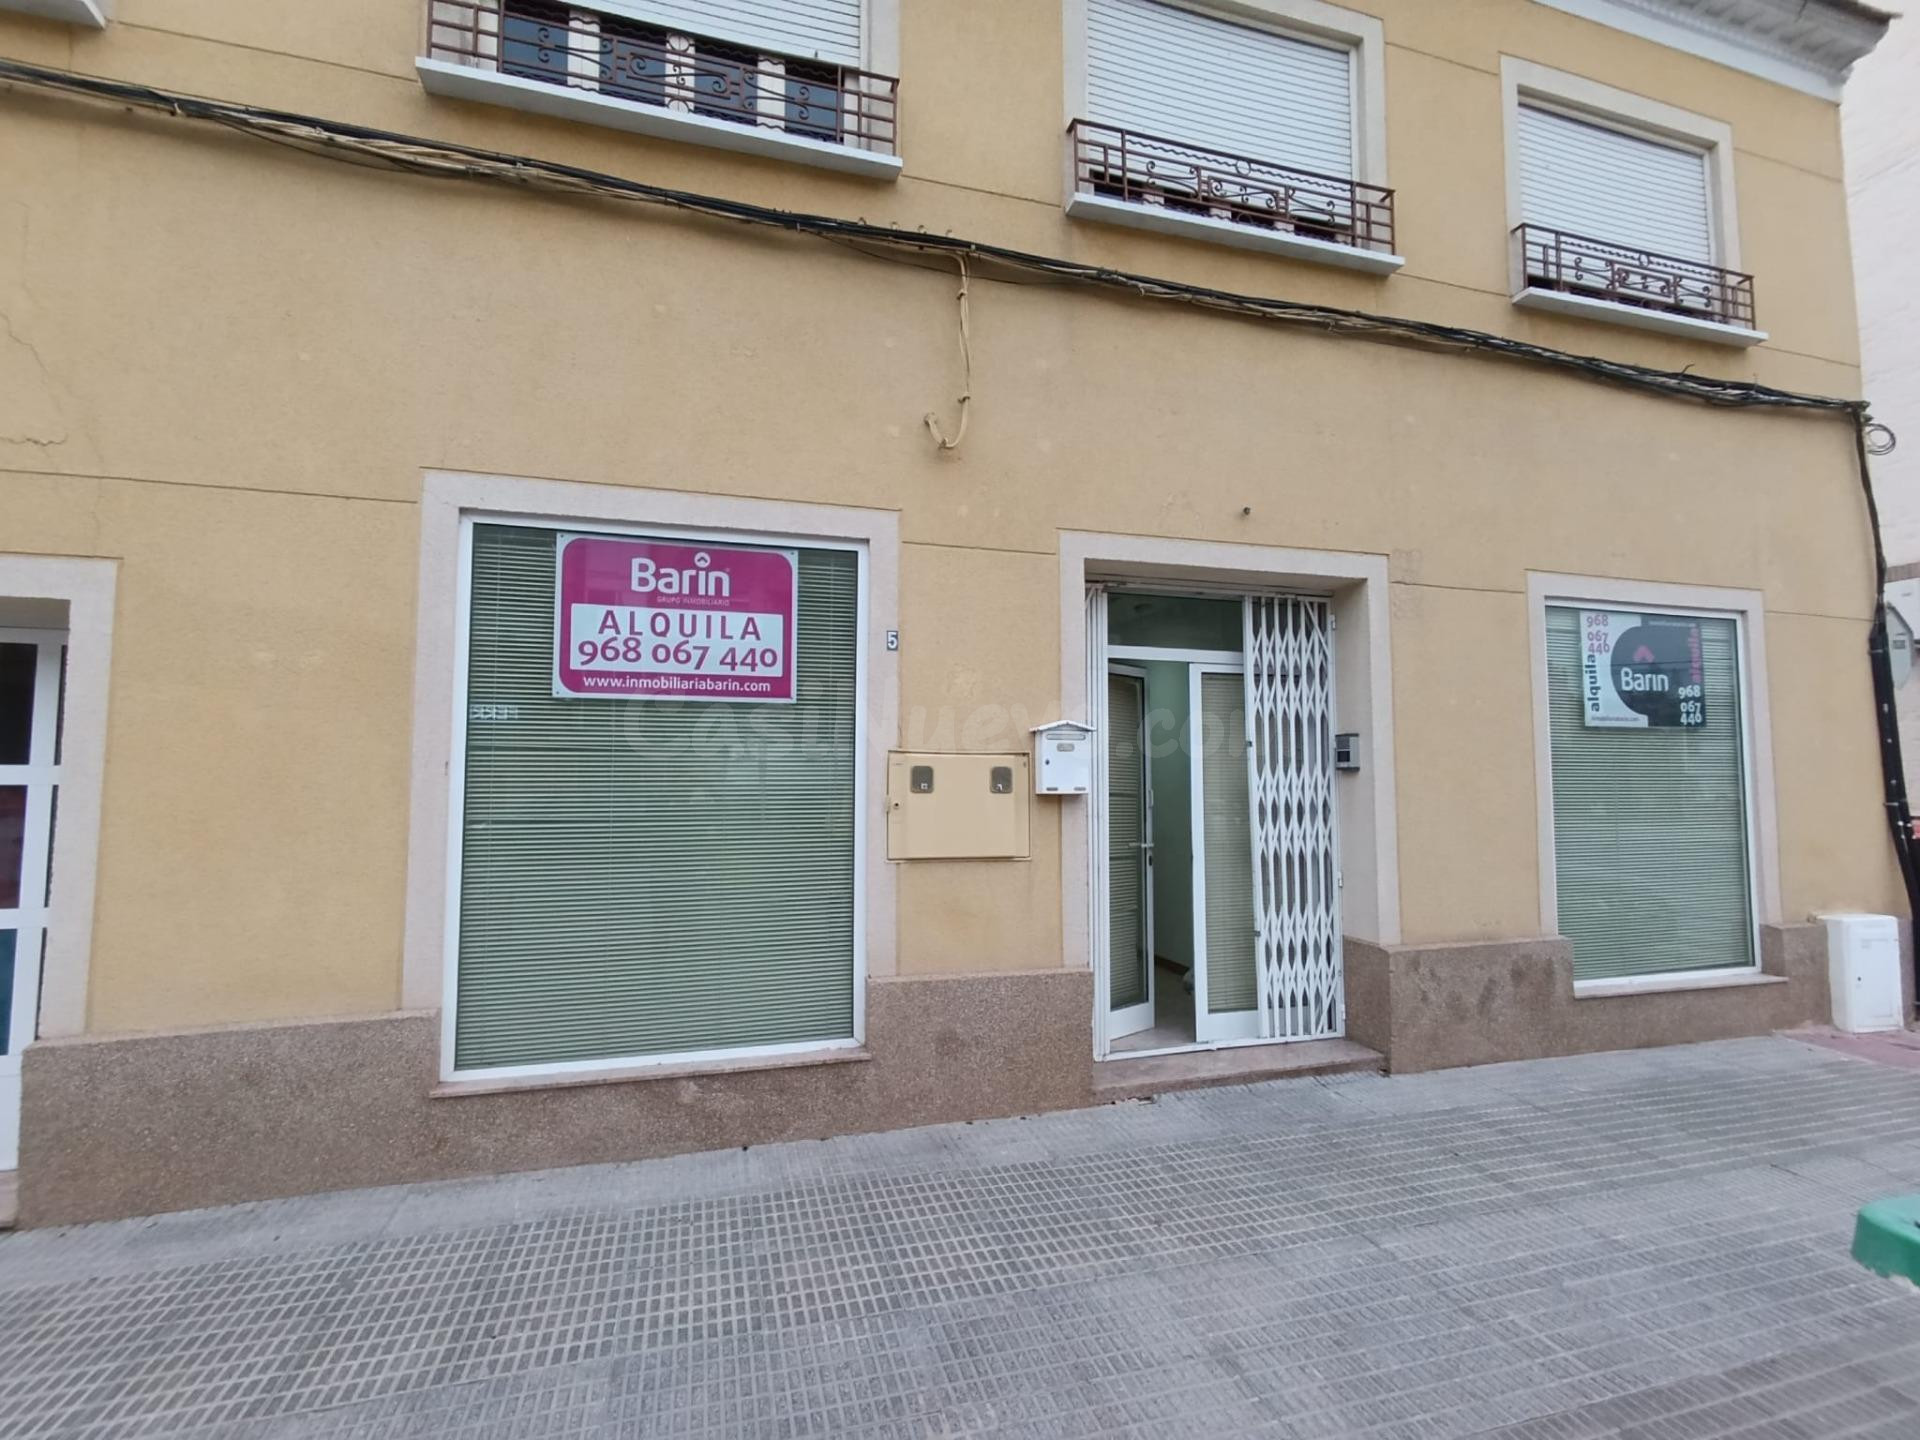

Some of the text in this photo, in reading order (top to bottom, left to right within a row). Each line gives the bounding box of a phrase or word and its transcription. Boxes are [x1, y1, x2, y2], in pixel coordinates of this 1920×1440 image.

[631, 552, 730, 597] Barin
[598, 610, 761, 641] ALQUILA
[1586, 614, 1609, 628] 968
[887, 631, 898, 649] 5
[1587, 631, 1609, 643] 067
[578, 636, 778, 672] 968 067 440
[584, 676, 771, 692] www.inmobiliariabarin.com
[1585, 654, 1601, 712] alquila
[1678, 685, 1701, 699] 968
[1680, 701, 1702, 715] 067
